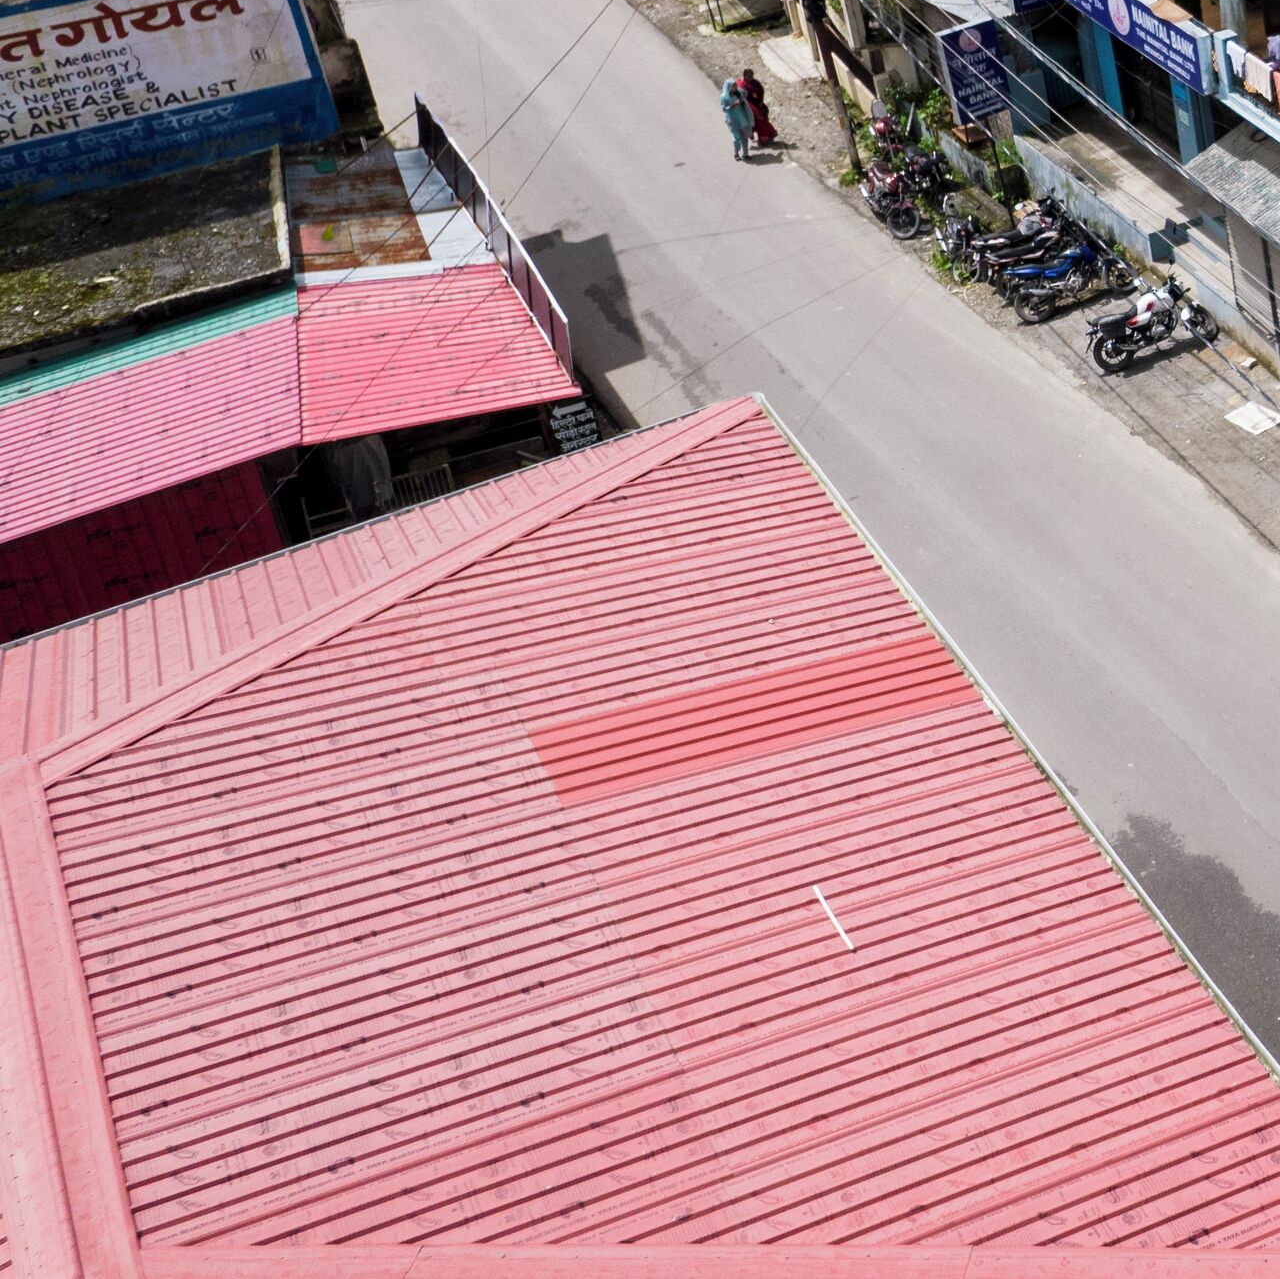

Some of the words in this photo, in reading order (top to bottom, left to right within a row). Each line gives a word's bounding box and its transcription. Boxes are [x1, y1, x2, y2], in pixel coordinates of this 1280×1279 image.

[1131, 4, 1170, 44] NAINITAL
[1170, 30, 1196, 62] BANK
[23, 71, 147, 106] Nephrologist
[28, 88, 130, 120] DISEASE
[145, 81, 160, 94] &
[95, 79, 237, 123] SPECIALIST
